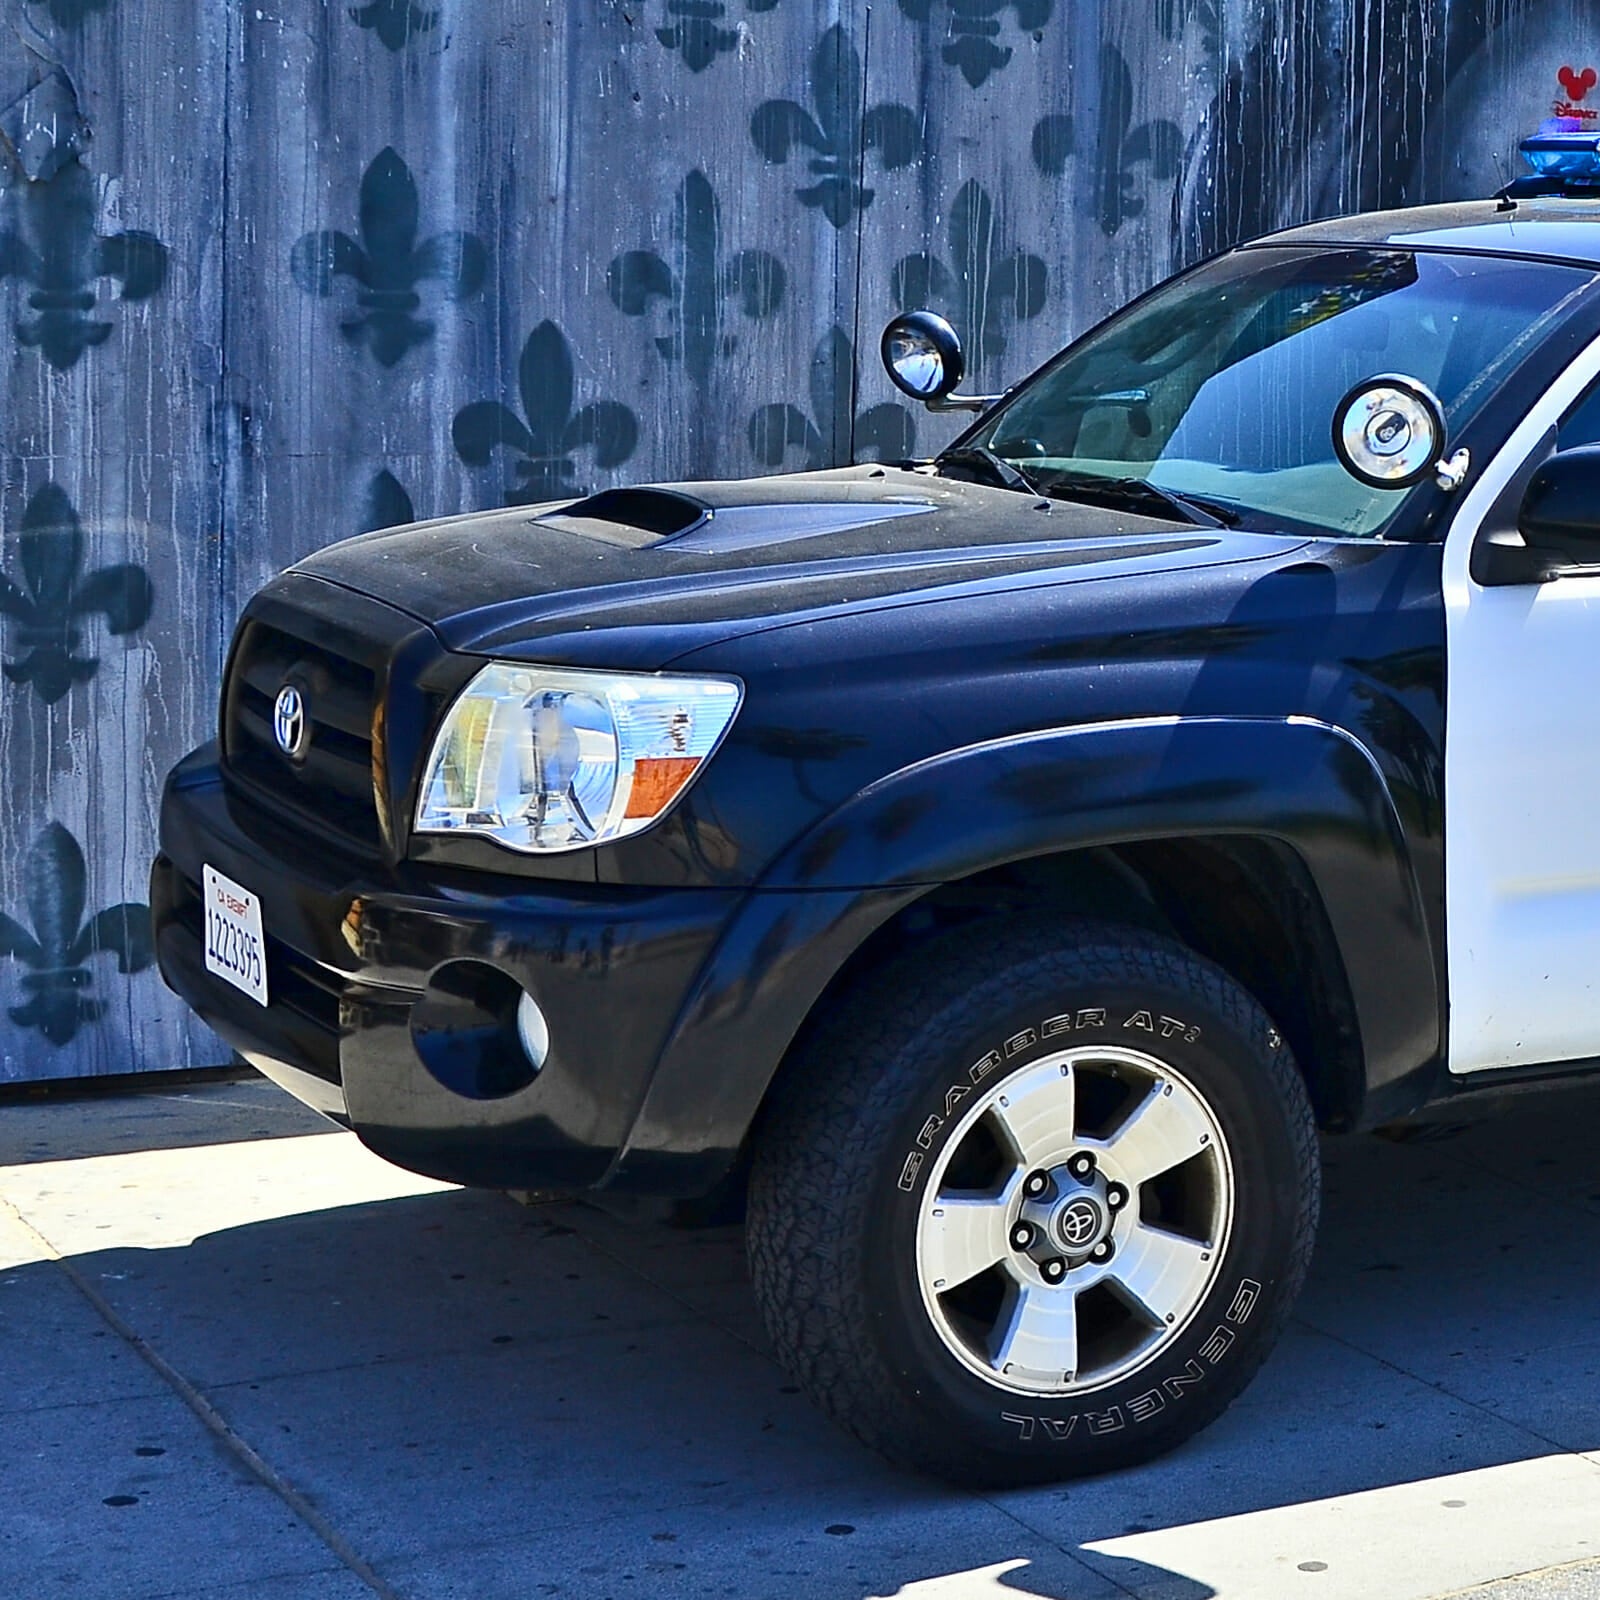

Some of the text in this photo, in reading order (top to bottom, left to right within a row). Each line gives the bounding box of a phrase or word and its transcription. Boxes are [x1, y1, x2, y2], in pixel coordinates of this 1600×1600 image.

[208, 908, 261, 987] 1223395
[897, 1008, 1107, 1192] GRABBER
[1000, 1278, 1262, 1440] GENERAL
